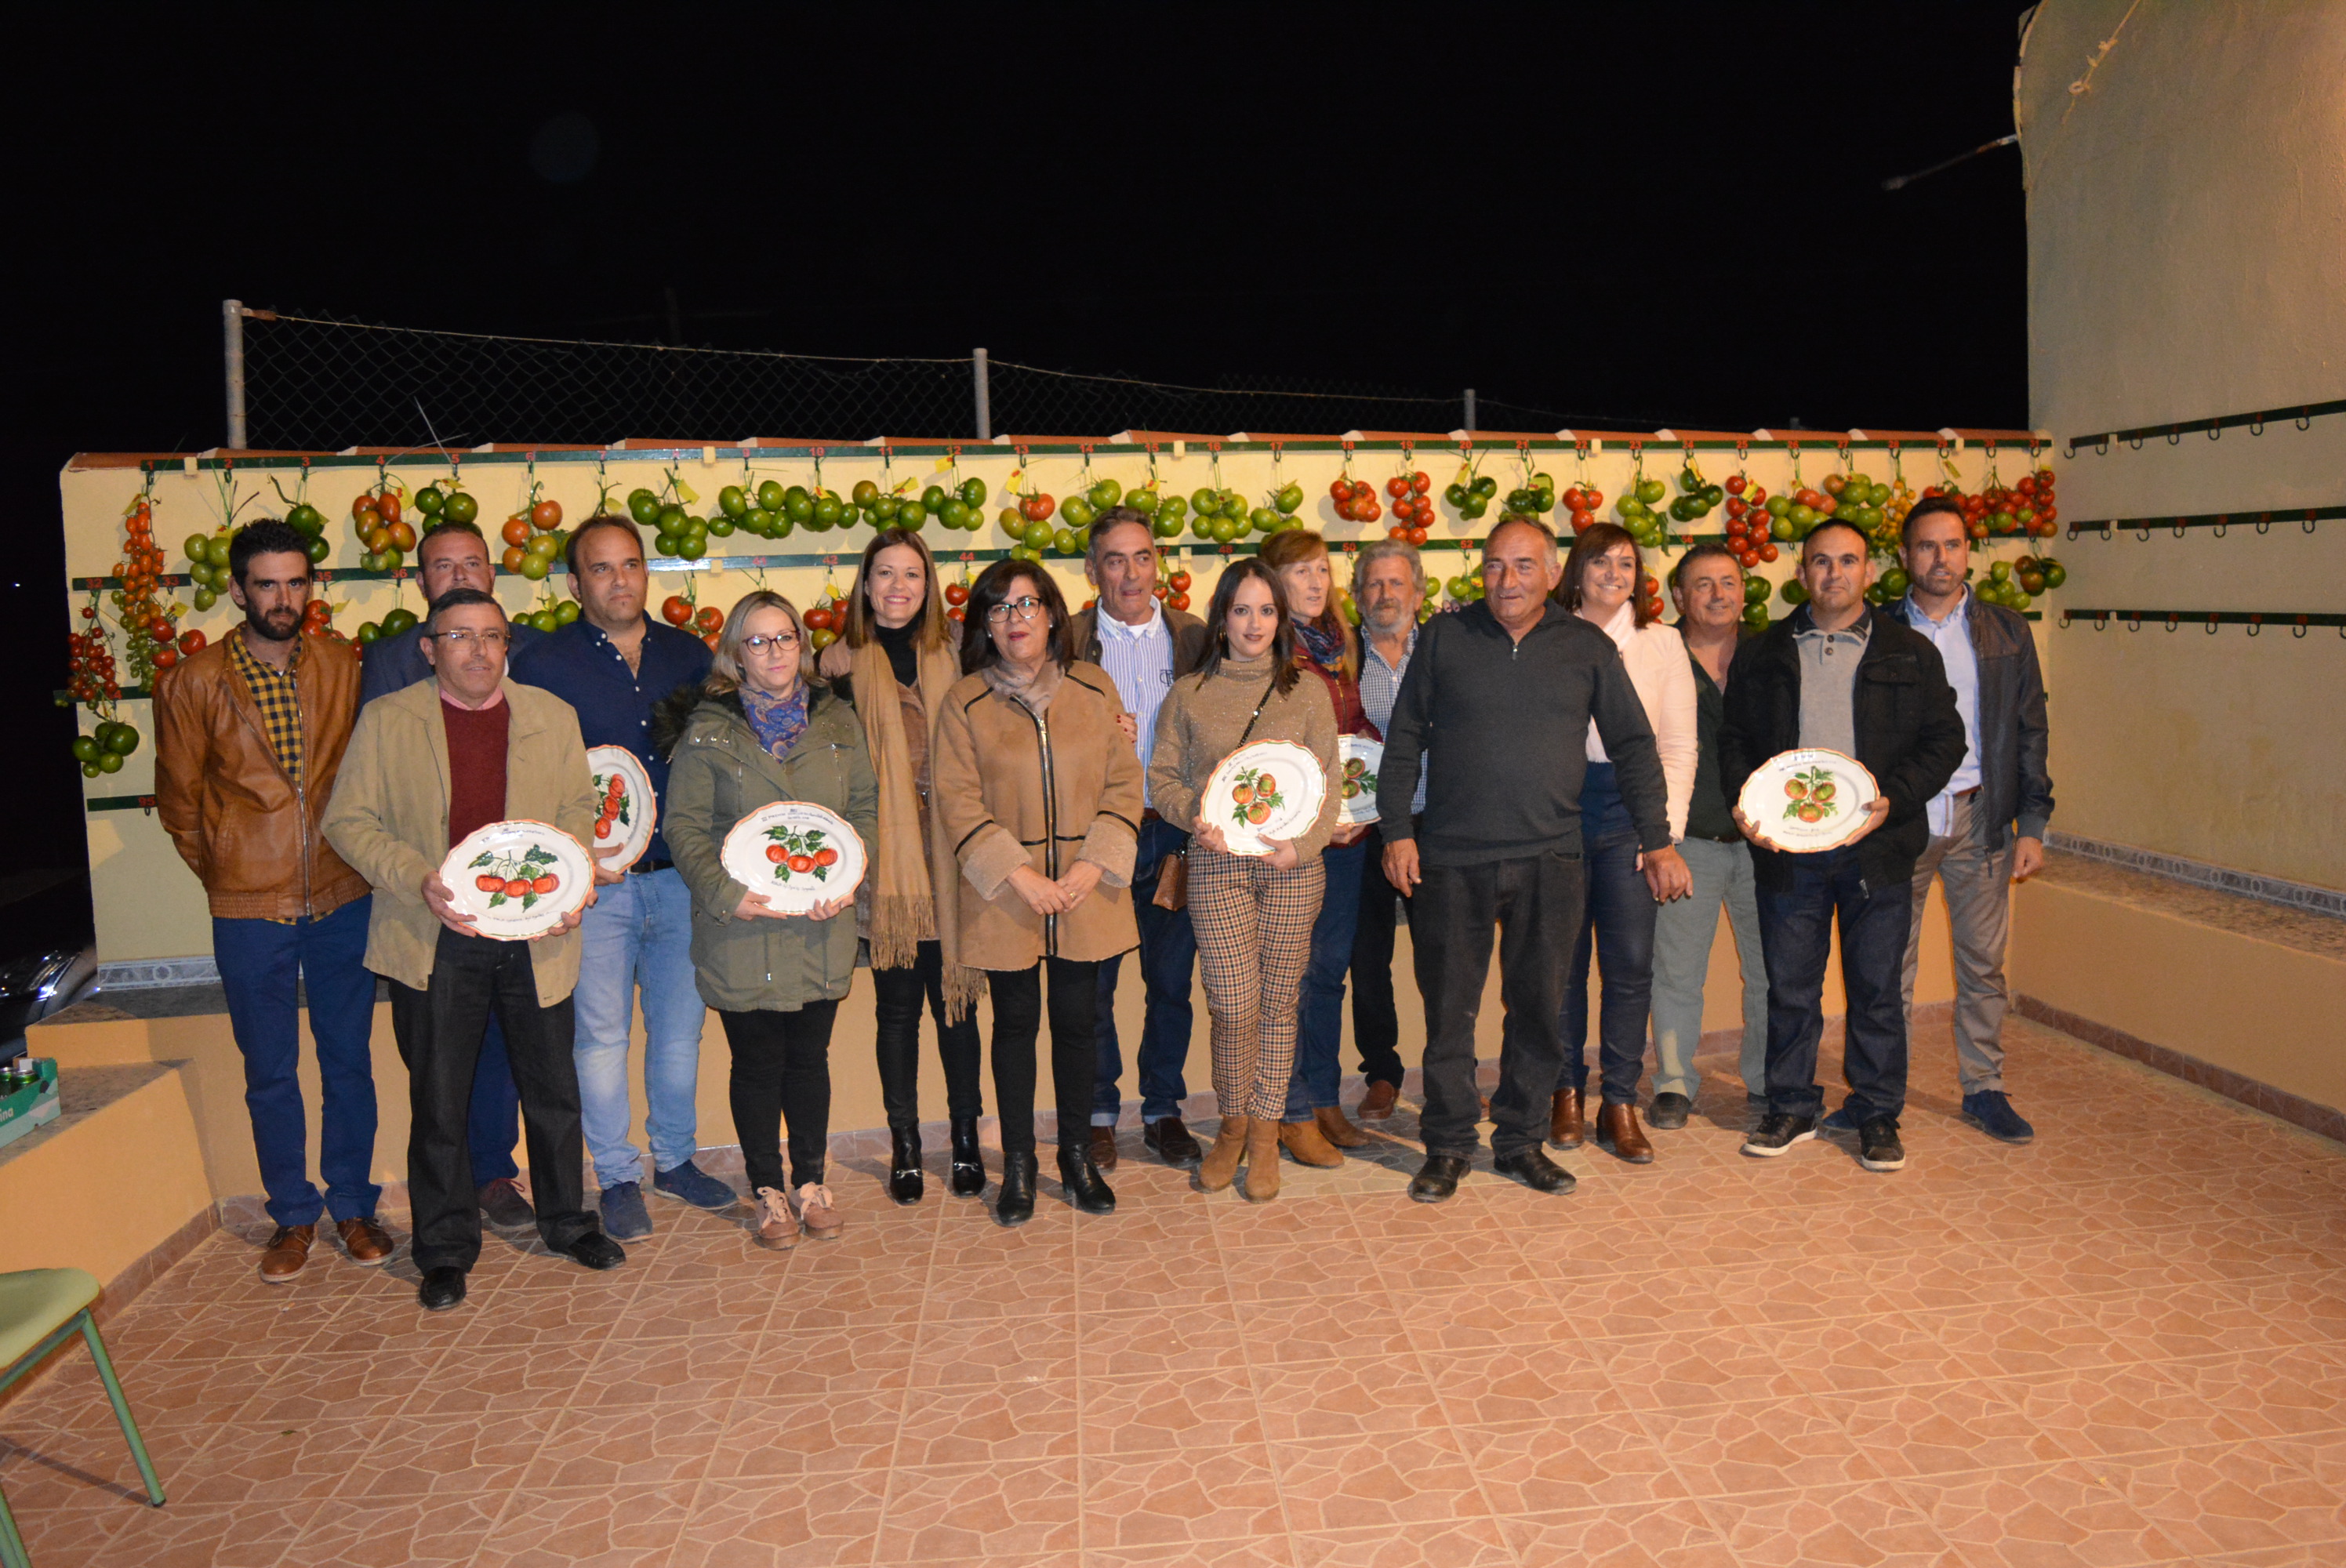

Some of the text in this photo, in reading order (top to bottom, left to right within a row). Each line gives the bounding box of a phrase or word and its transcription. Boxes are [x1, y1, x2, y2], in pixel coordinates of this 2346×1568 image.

[1079, 444, 1094, 453] 14
[1145, 444, 1160, 452] 15
[1207, 442, 1222, 452] 16
[1269, 441, 1284, 451] 17
[1342, 441, 1355, 449] 18
[1400, 441, 1414, 449] 19
[1459, 441, 1473, 450] 20
[1516, 440, 1529, 449] 21
[1575, 440, 1588, 449] 22
[1629, 440, 1642, 449] 23
[1736, 440, 1749, 449] 25
[1888, 440, 1900, 448] 28
[743, 448, 750, 458] 9
[809, 447, 825, 456] 10
[878, 446, 892, 456] 11
[946, 446, 961, 455] 12
[1014, 445, 1029, 455] 13
[376, 456, 385, 464] 4
[452, 454, 459, 463] 5
[599, 451, 606, 460] 7
[148, 461, 154, 470] 1
[224, 459, 233, 468] 2
[302, 456, 310, 466] 3
[1342, 543, 1356, 552] 50
[1461, 539, 1473, 549] 52
[1218, 545, 1233, 554] 48
[823, 556, 837, 564] 42
[960, 552, 975, 561] 44
[752, 557, 766, 566] 41
[316, 572, 332, 582] 35
[391, 568, 408, 579] 36
[85, 578, 103, 588] 32
[162, 575, 178, 586] 33
[139, 797, 155, 806] 95
